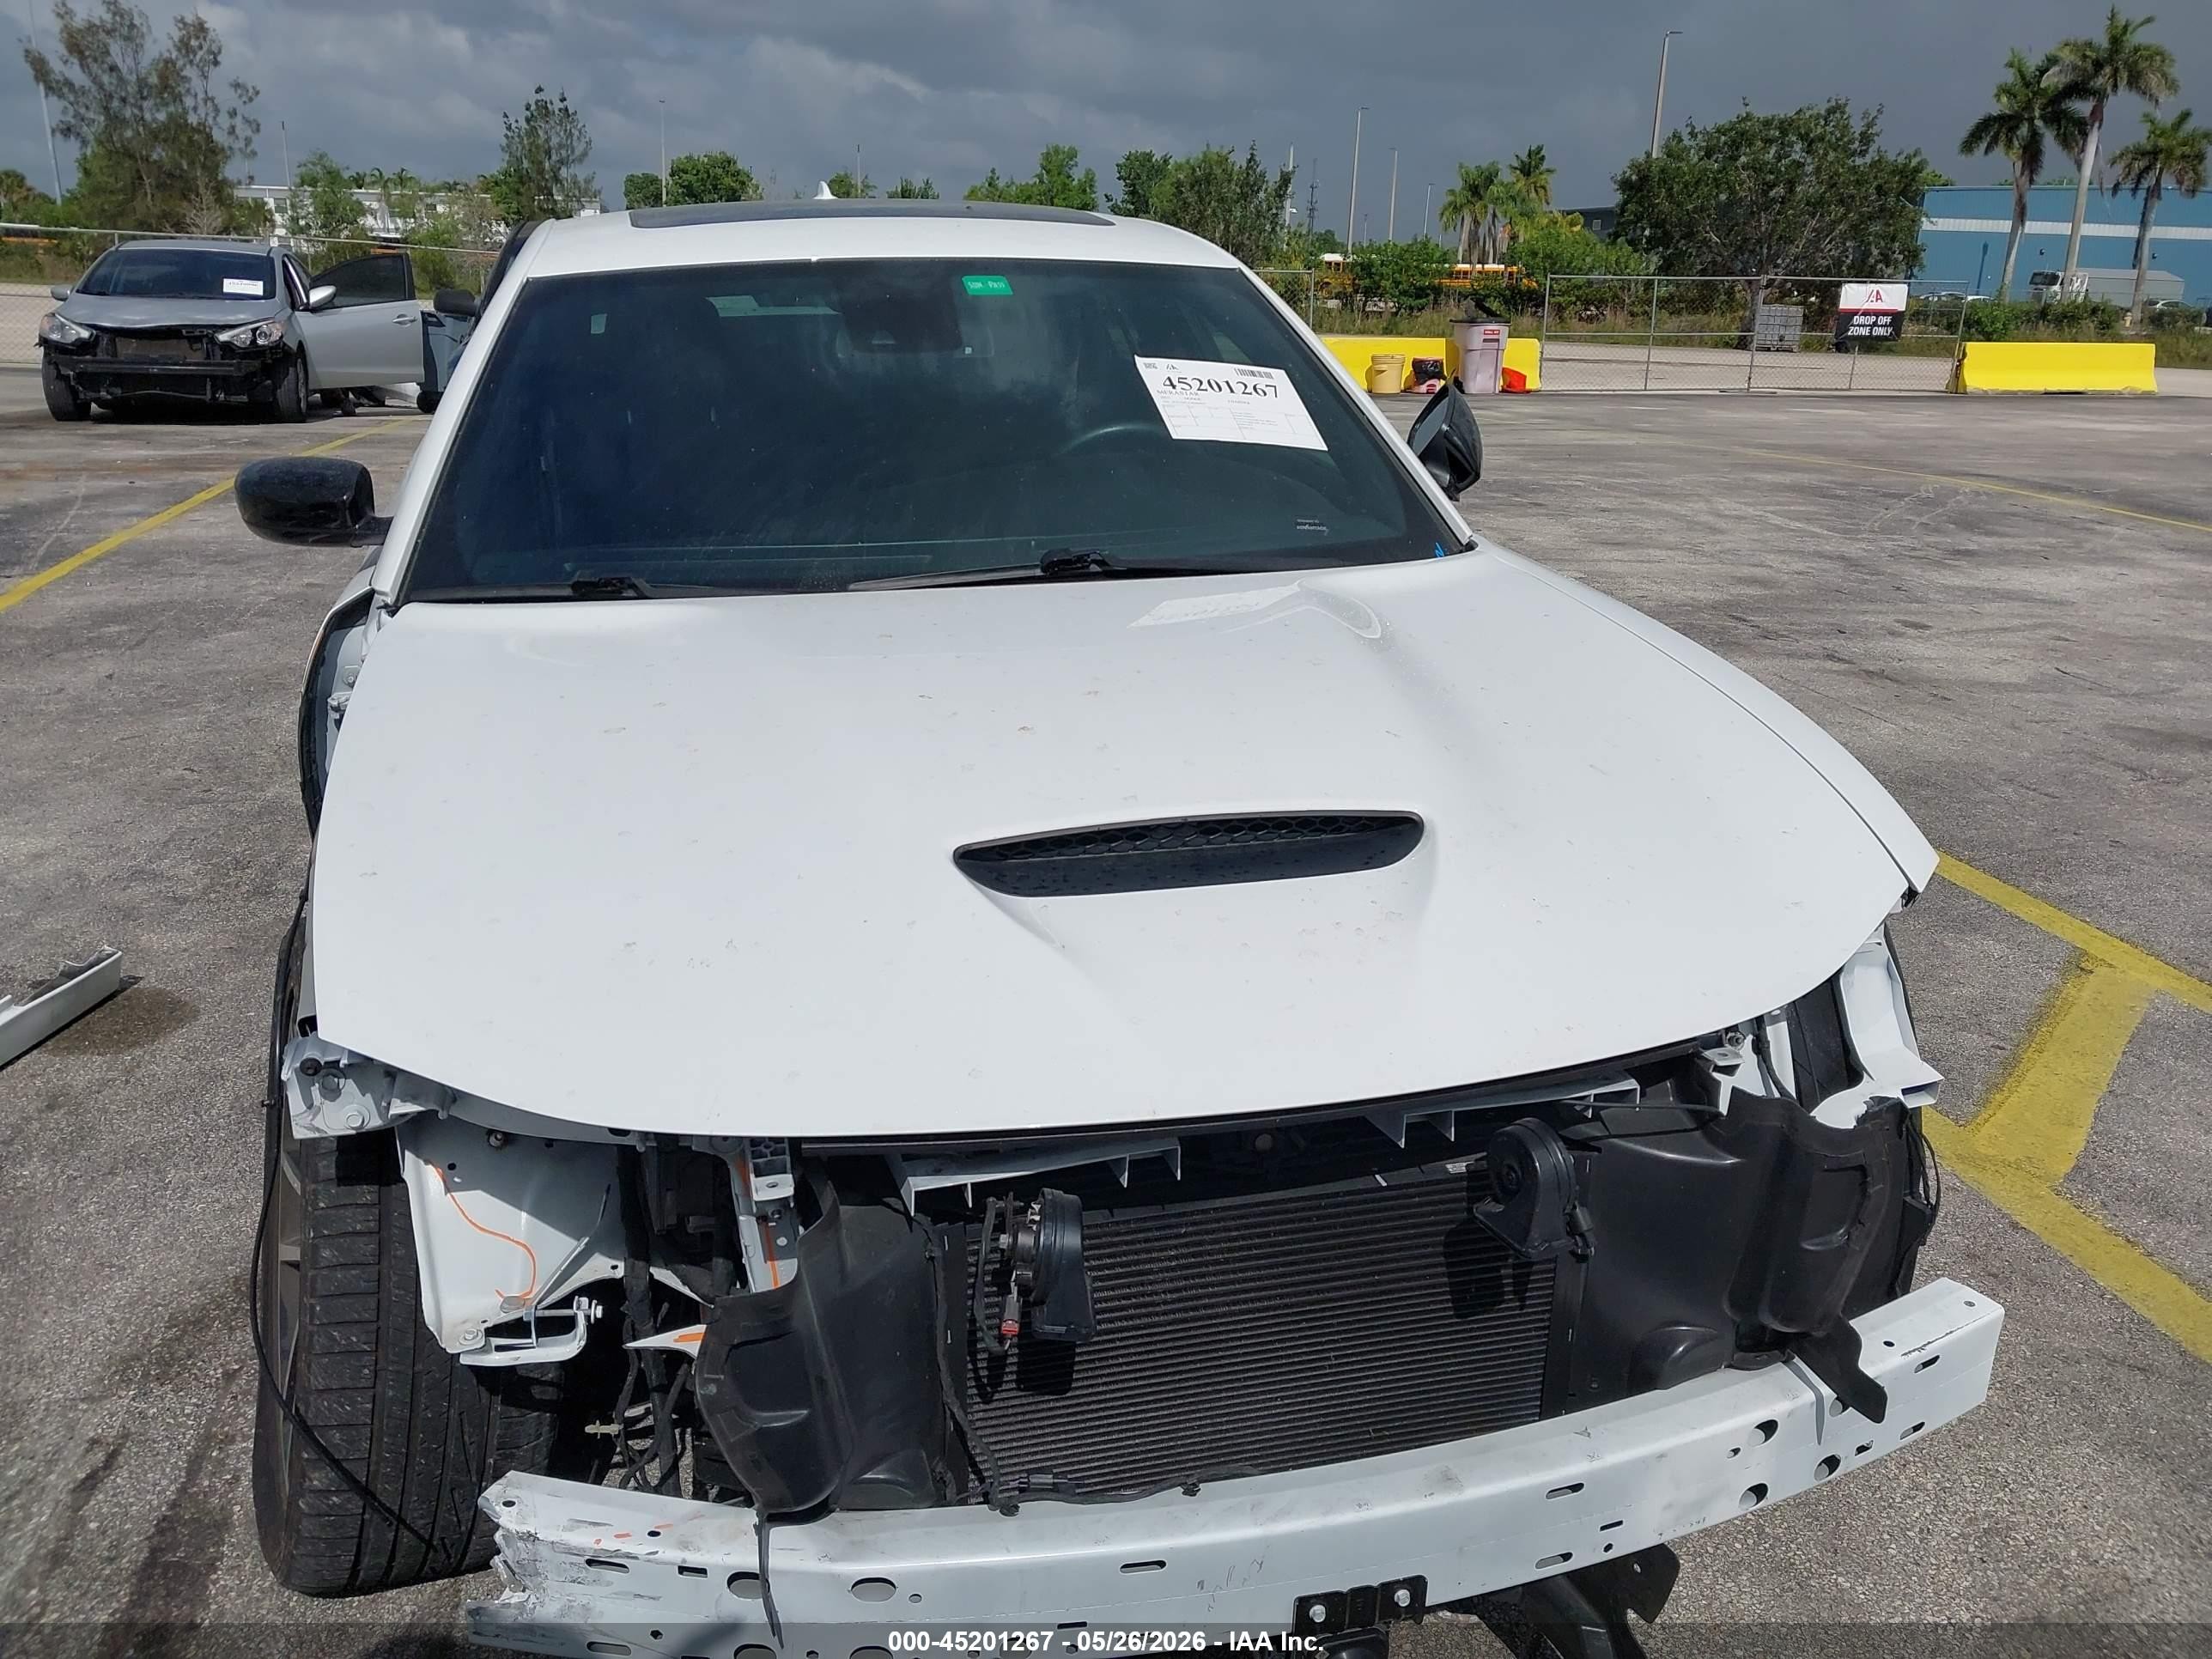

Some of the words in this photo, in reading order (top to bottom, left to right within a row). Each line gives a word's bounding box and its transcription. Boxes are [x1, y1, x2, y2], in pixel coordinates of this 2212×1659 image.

[1853, 315, 1876, 325] DROP
[1877, 315, 1893, 325] OFF
[1847, 326, 1872, 336] ZONE
[1872, 326, 1893, 336] ONLY
[1162, 375, 1279, 398] 45201267
